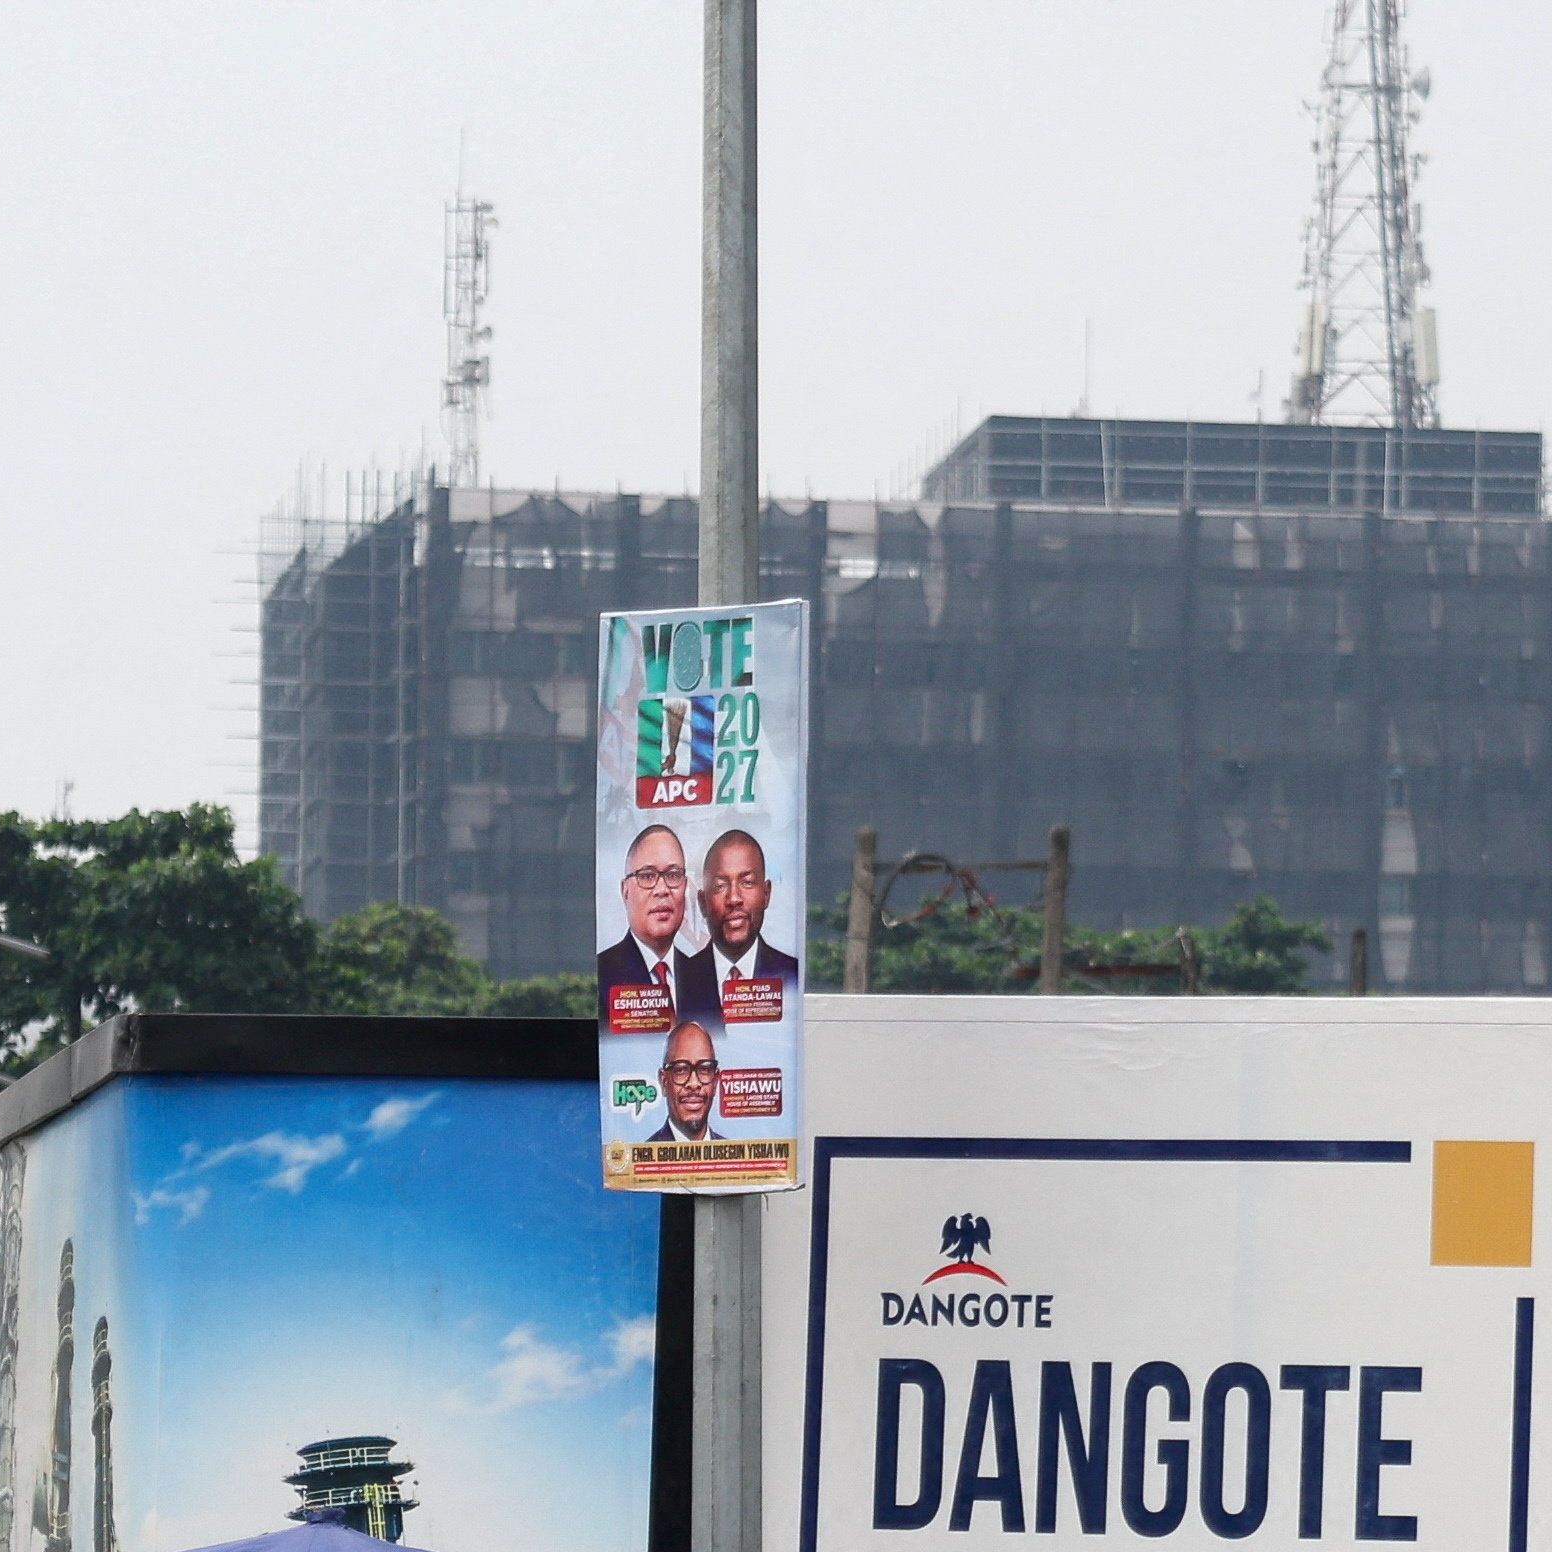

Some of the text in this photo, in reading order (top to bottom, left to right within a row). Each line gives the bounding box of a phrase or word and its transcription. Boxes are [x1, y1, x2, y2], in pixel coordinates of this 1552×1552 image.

[641, 618, 754, 694] VOTE
[716, 692, 761, 748] 20
[651, 779, 698, 804] APC
[715, 749, 760, 804] 27
[613, 997, 669, 1010] ESHILOKUN
[613, 1080, 658, 1116] Hope
[721, 1079, 782, 1095] YISHAWU
[880, 1292, 1054, 1328] DANGOTE
[872, 1357, 1423, 1542] DANGOTE
